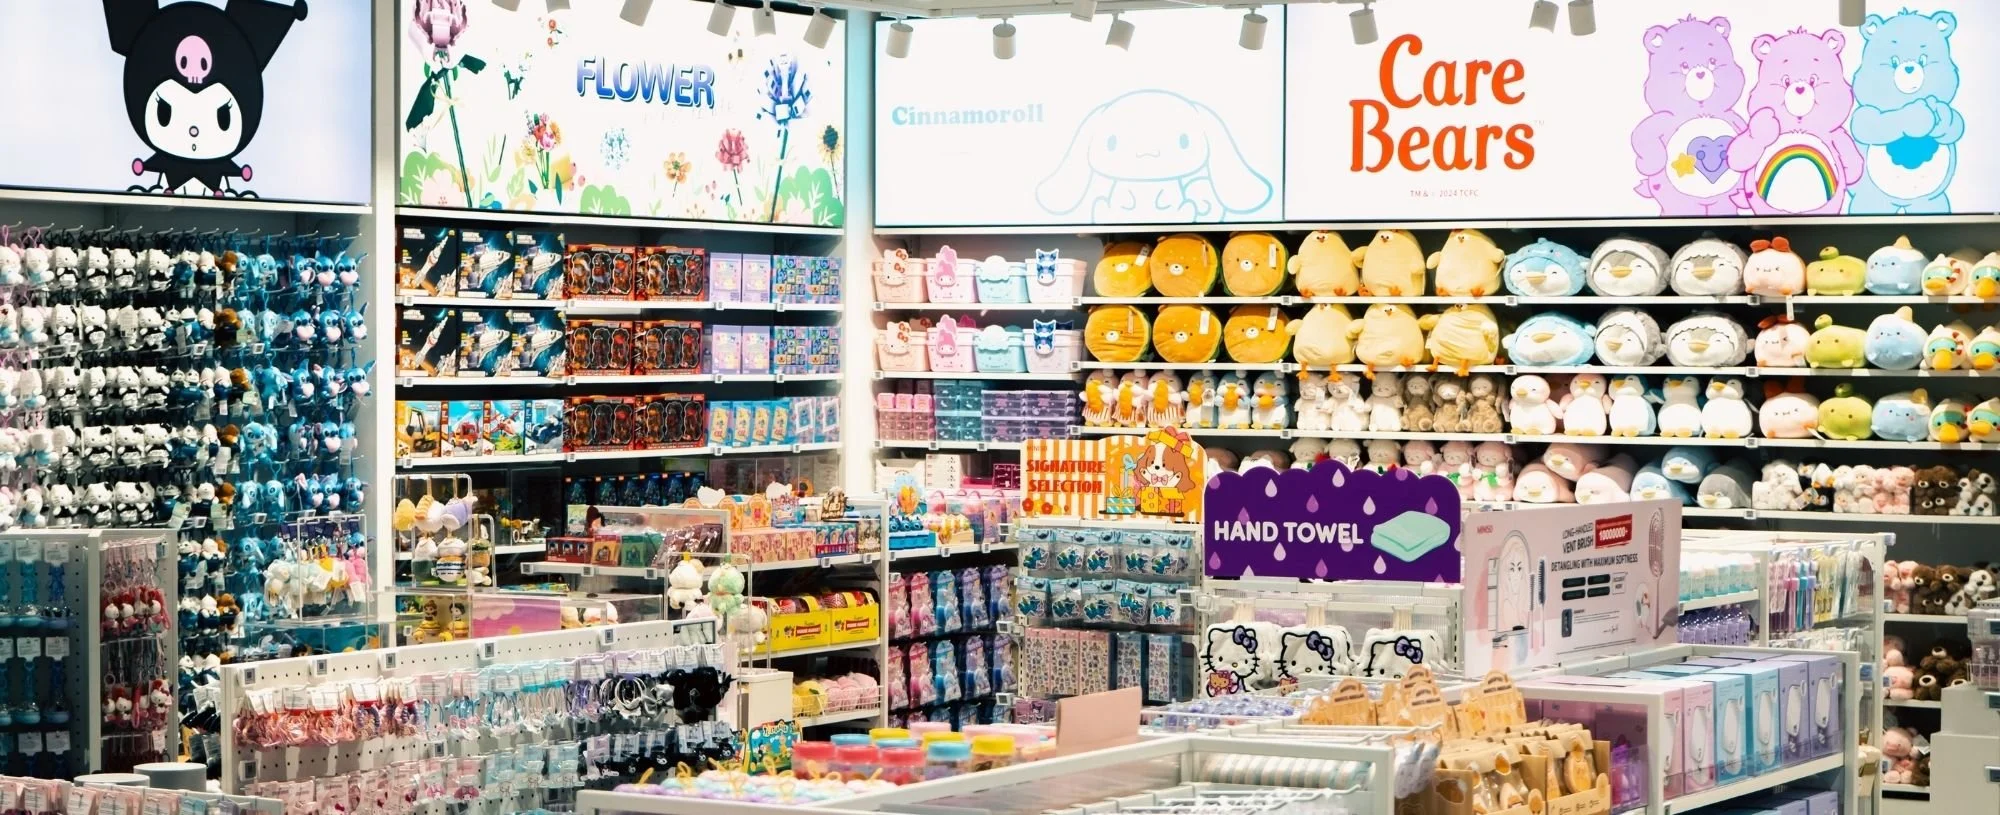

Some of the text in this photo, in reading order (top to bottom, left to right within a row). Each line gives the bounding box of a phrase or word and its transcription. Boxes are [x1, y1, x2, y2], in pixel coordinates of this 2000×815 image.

[1379, 33, 1526, 109] Care
[576, 55, 716, 109] FLOWER
[891, 103, 1045, 126] Cinnamoroll
[1349, 99, 1536, 173] Bears
[1440, 189, 1457, 197] 2024
[1459, 189, 1479, 197] TCFC
[1026, 459, 1106, 473] SIGNATURE
[1028, 479, 1103, 493] SELECTION
[1213, 520, 1364, 545] HAND TOWEL
[1562, 535, 1594, 554] VENT BRUSH
[1551, 553, 1638, 572] DETANGLING WITH MAXIMUM SOFTNESS
